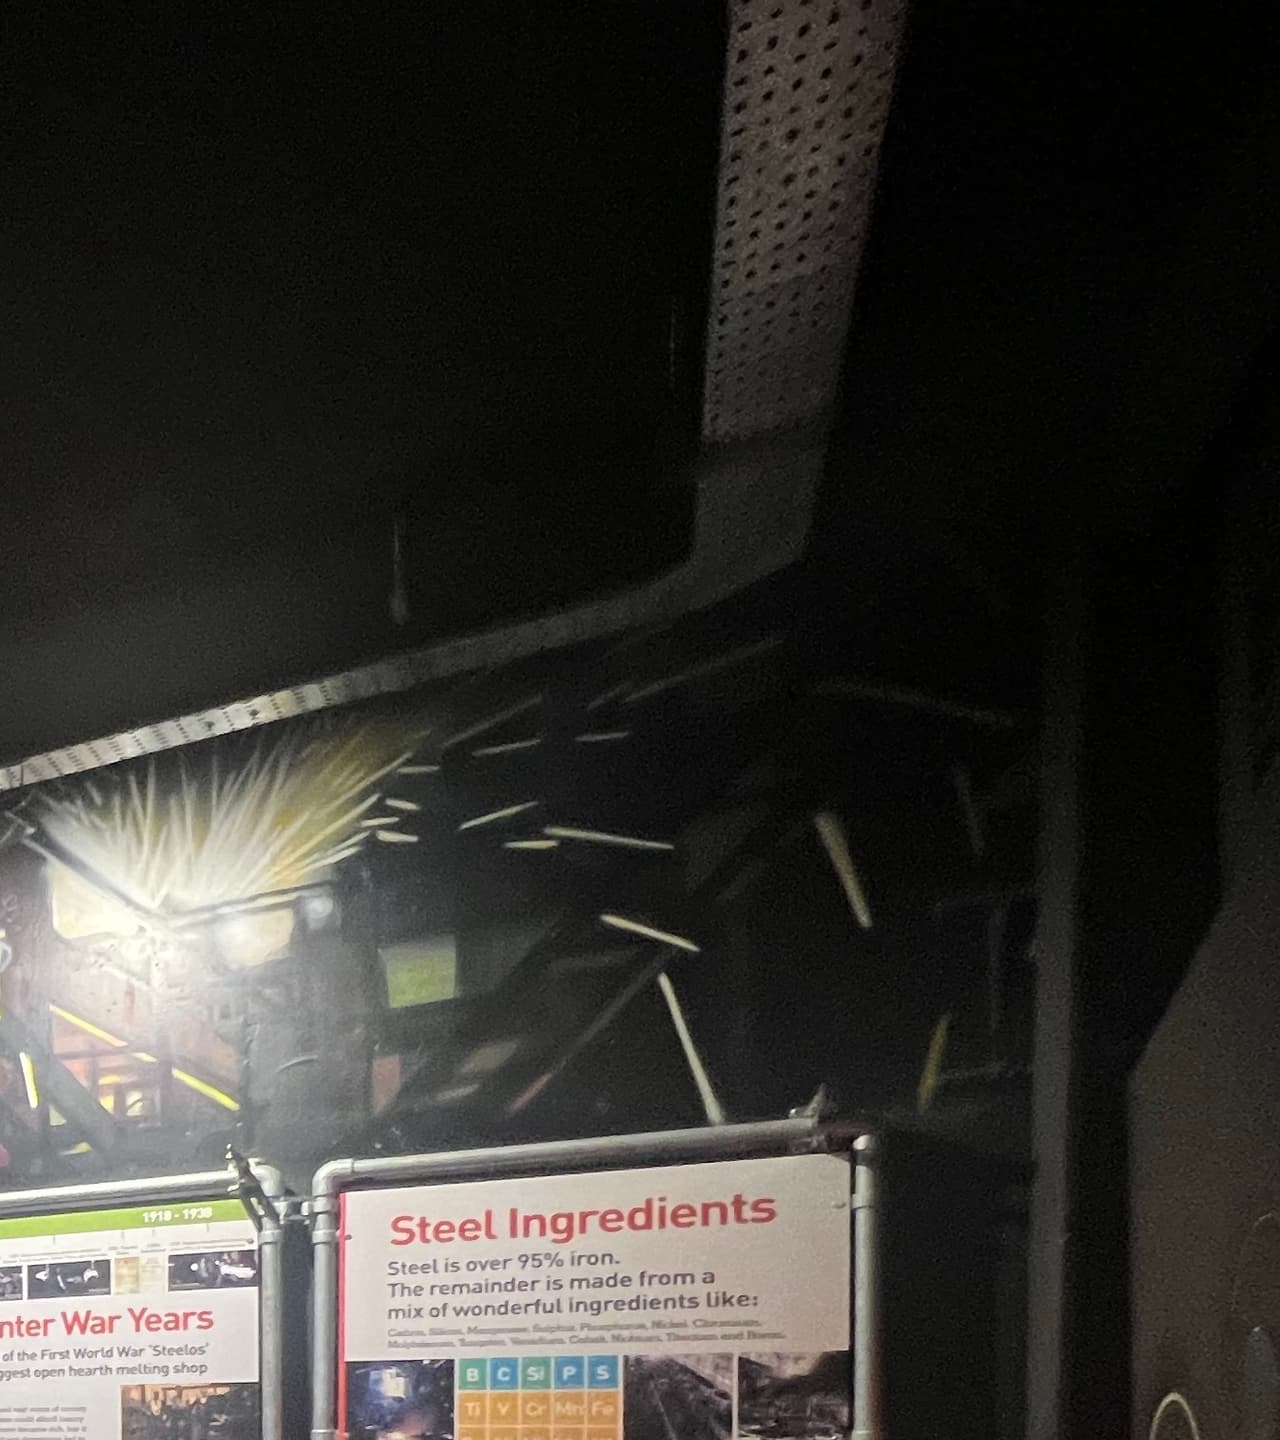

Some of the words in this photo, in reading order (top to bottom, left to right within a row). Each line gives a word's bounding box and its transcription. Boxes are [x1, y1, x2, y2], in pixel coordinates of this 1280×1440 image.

[390, 1209, 497, 1246] Steel
[509, 1194, 777, 1244] Ingredients
[387, 1259, 438, 1276] Steel
[444, 1256, 460, 1273] is
[466, 1256, 512, 1272] over
[517, 1252, 564, 1269] 95%
[569, 1250, 621, 1267] iron.
[387, 1282, 424, 1298] The
[429, 1276, 540, 1296] remainder
[546, 1276, 564, 1291] is
[569, 1272, 632, 1290] made
[639, 1270, 694, 1287] from
[702, 1271, 715, 1285] a
[387, 1304, 424, 1320] mix
[428, 1301, 450, 1318] of
[453, 1297, 561, 1316] wonderful
[568, 1293, 699, 1316] ingredients
[706, 1291, 759, 1308] like:
[61, 1310, 122, 1335] War
[127, 1307, 214, 1332] Years
[2, 1350, 16, 1361] of
[17, 1351, 37, 1361] the
[41, 1348, 70, 1360] First
[74, 1347, 114, 1359] World
[117, 1346, 146, 1357] War
[34, 1368, 66, 1380] open
[69, 1364, 113, 1376] hearth
[116, 1363, 170, 1377] melting
[173, 1362, 208, 1375] shop
[466, 1368, 479, 1382] B
[497, 1367, 510, 1381] C
[527, 1366, 544, 1381] Si
[562, 1366, 576, 1381] P
[596, 1365, 610, 1380] S
[497, 1403, 510, 1416] V
[525, 1402, 547, 1416] Cr
